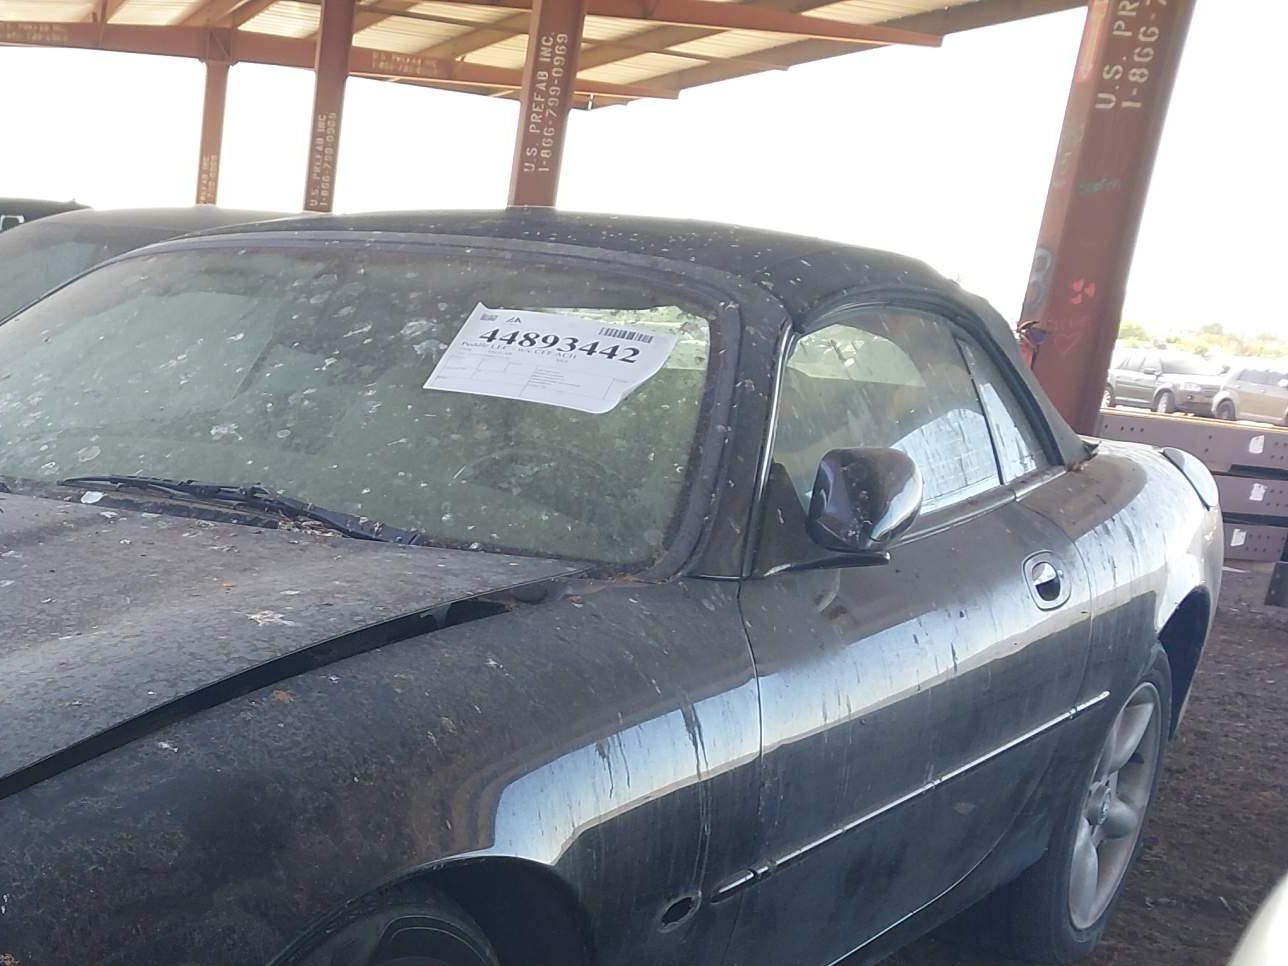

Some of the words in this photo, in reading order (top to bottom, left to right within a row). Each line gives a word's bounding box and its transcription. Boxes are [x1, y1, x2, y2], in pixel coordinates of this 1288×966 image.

[528, 71, 549, 134] PREFAB
[538, 33, 569, 172] 1-866-799-0969
[1095, 56, 1127, 109] U.S.
[523, 143, 540, 173] U.S.
[479, 328, 641, 364] 44893442
